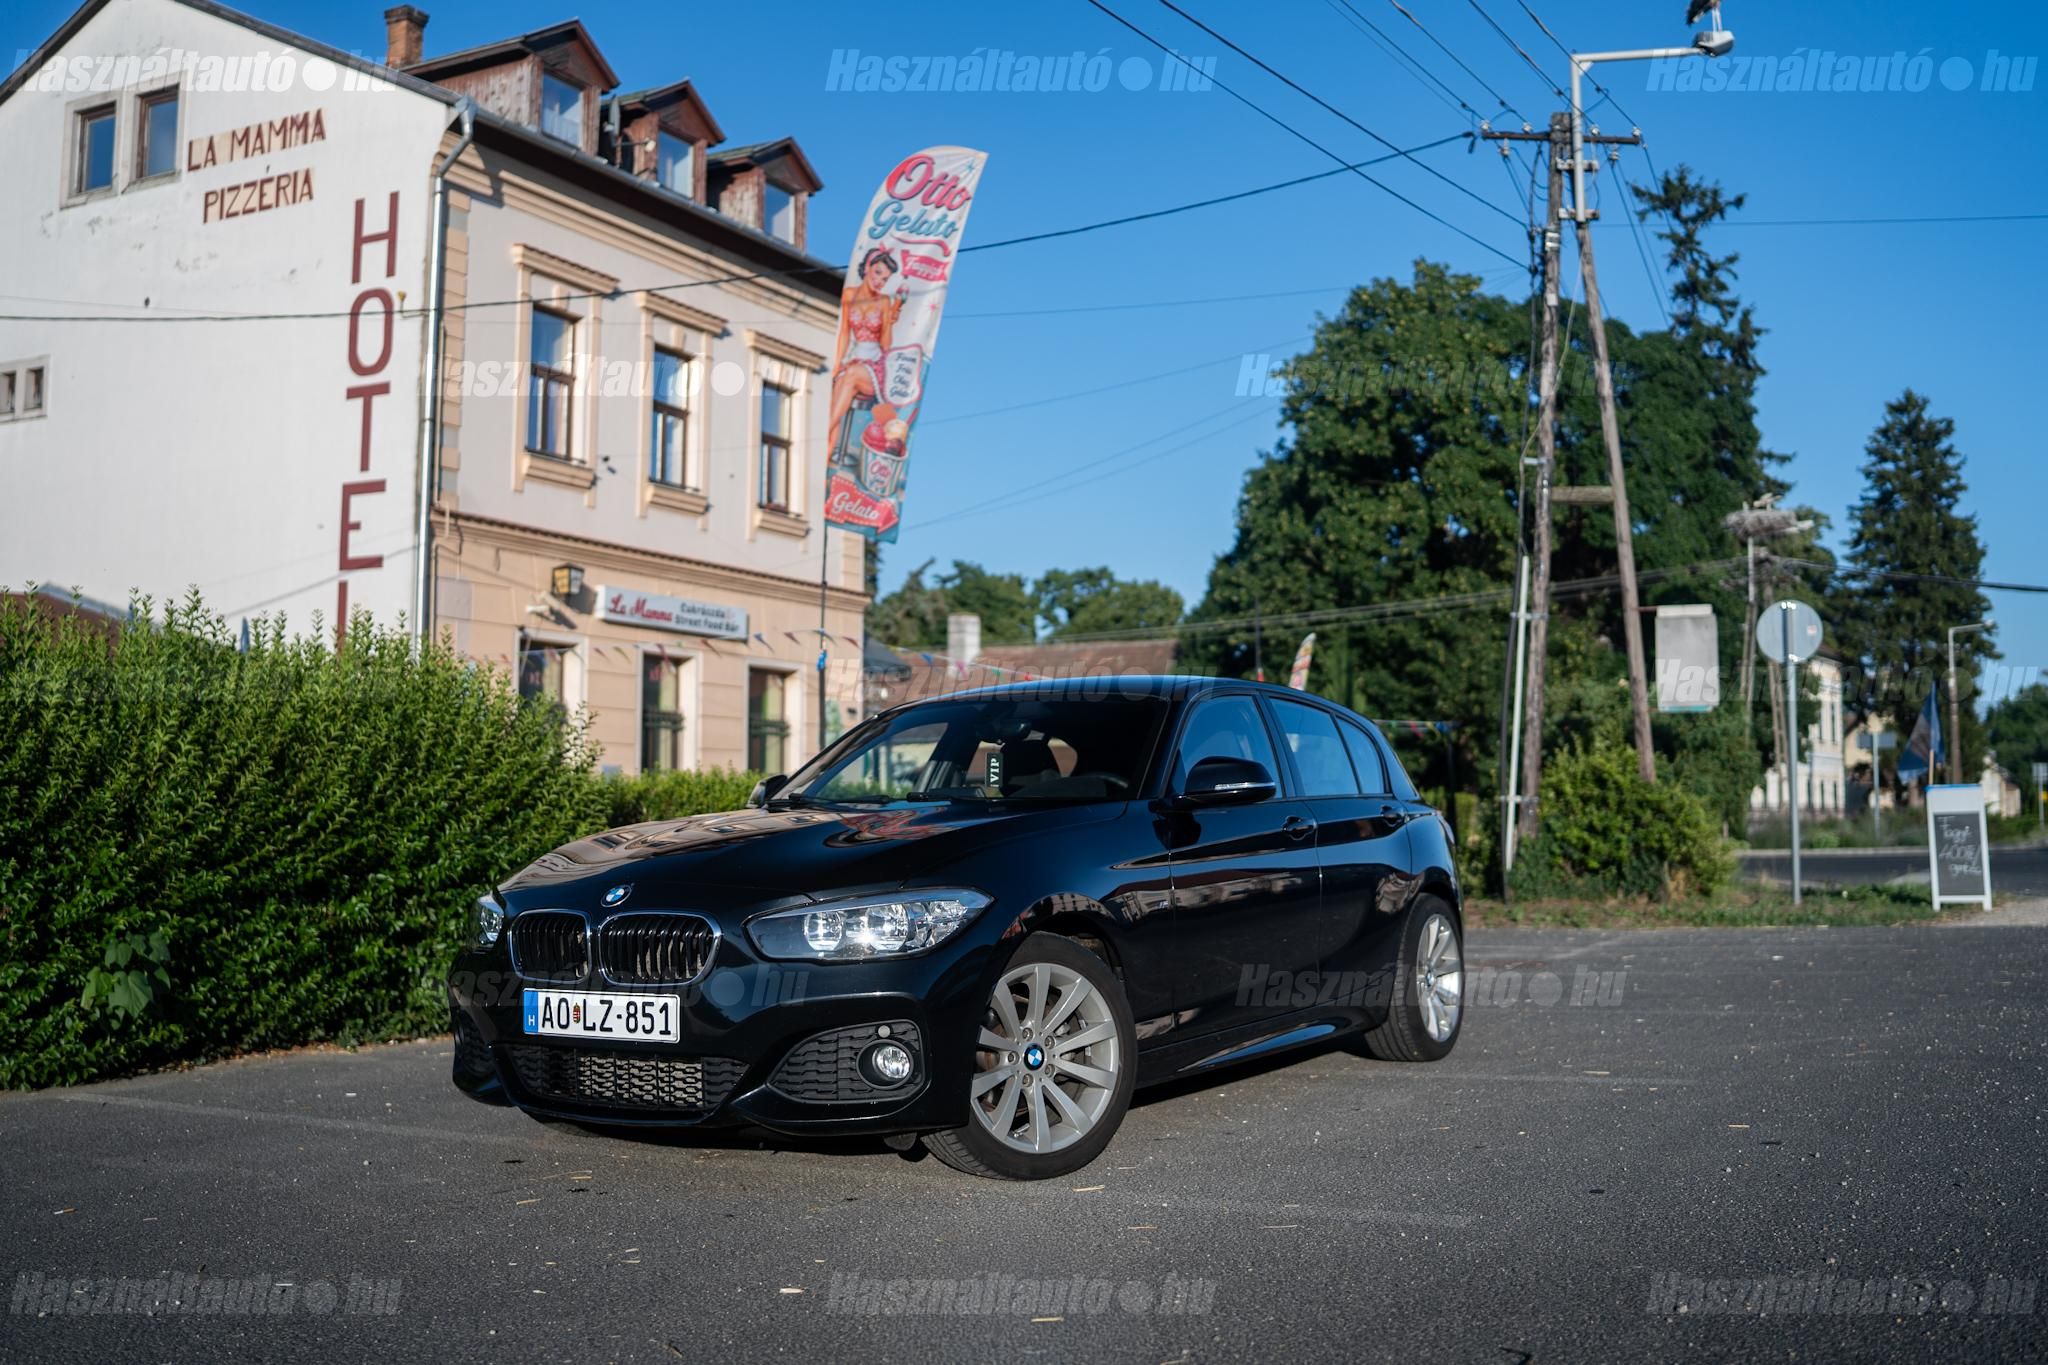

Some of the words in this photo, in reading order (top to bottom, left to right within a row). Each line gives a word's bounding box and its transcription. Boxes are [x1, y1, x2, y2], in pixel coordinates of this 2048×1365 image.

[188, 136, 217, 172] LA
[230, 108, 327, 162] MAMMA
[203, 165, 314, 224] PIZZÉRIA
[885, 153, 971, 211] Otto
[868, 200, 958, 239] Gelato
[831, 491, 880, 519] Gelato
[608, 593, 626, 615] La
[630, 597, 673, 622] Mamma
[675, 614, 701, 628] Street
[527, 1015, 536, 1026] H
[541, 996, 570, 1030] AO
